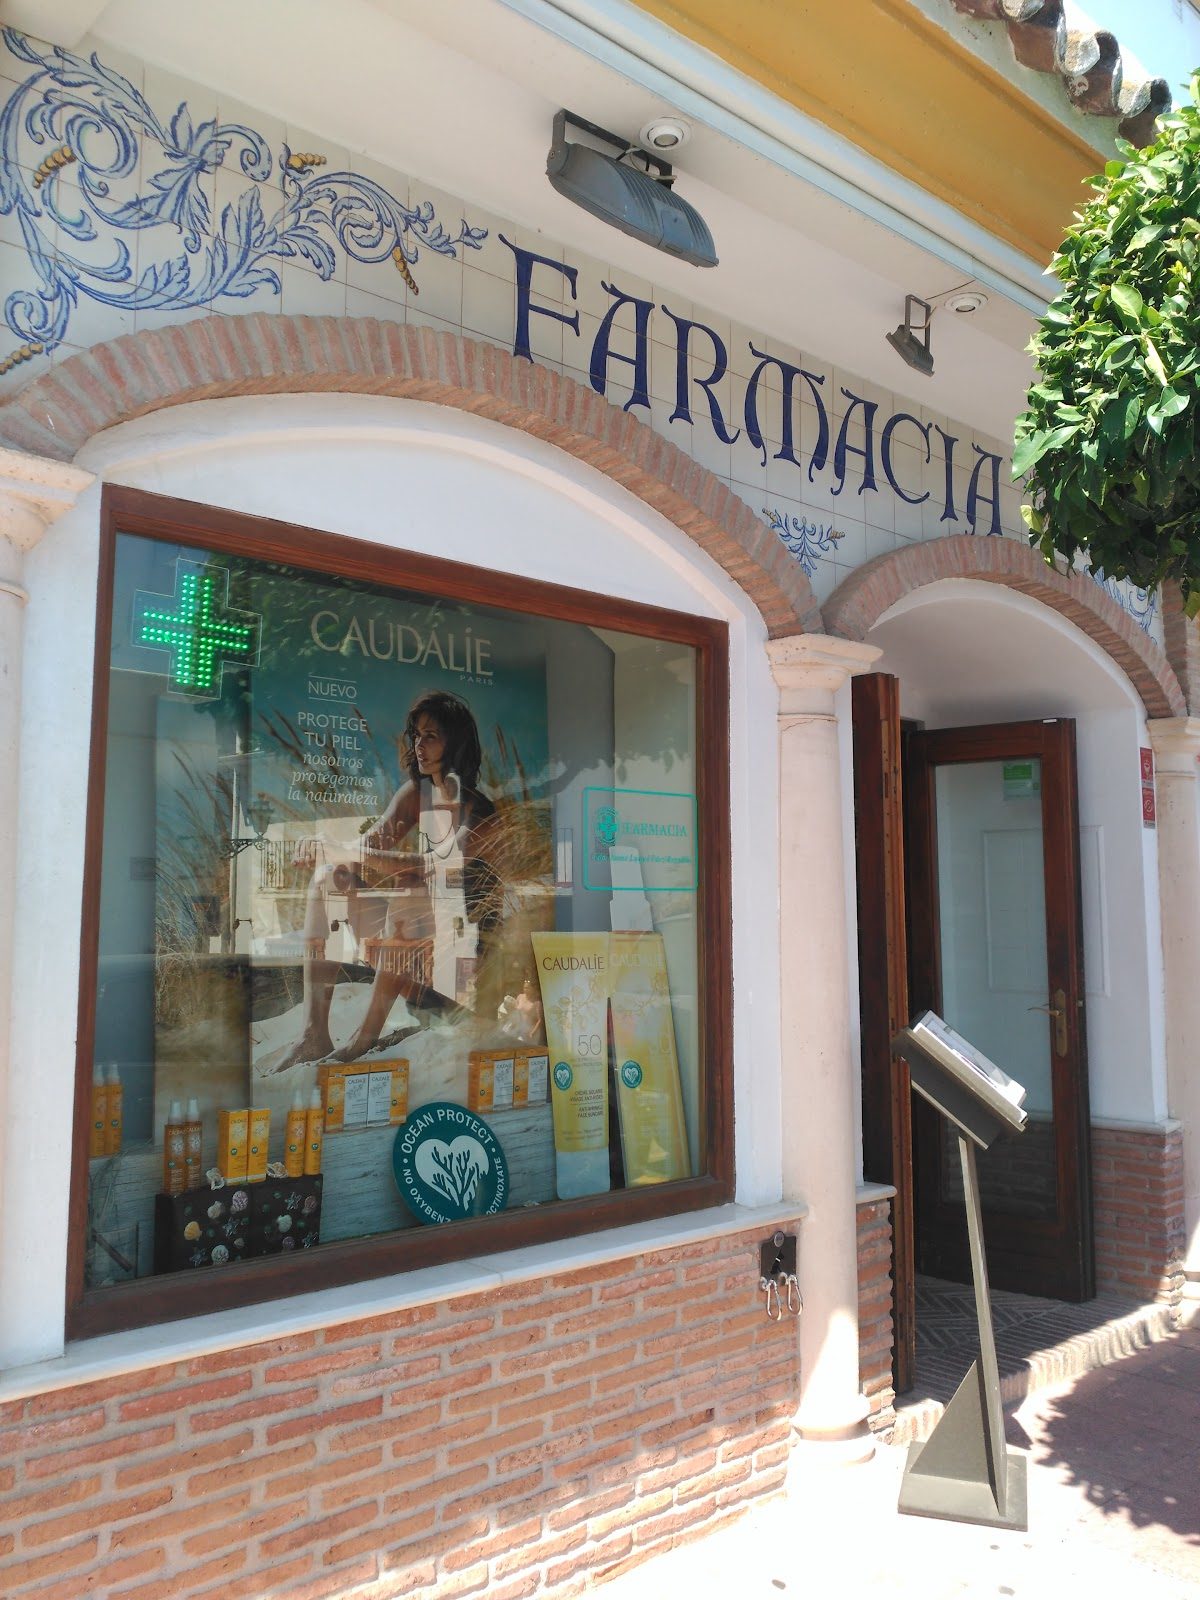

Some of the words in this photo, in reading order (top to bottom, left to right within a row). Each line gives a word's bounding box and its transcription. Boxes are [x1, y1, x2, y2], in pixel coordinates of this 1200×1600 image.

[498, 233, 1003, 536] FARMACIA
[459, 675, 494, 686] PARIS
[308, 681, 357, 699] NUEVO
[298, 712, 367, 732] PROTEGE
[305, 732, 326, 747] TU
[332, 735, 361, 751] PIEL
[303, 753, 364, 769] nosotros
[292, 771, 374, 788] protegemos
[288, 787, 301, 801] la
[305, 790, 378, 806] naturaleza
[622, 822, 687, 836] FARMACIA
[578, 1034, 602, 1056] 50
[401, 1112, 434, 1154] OCEAN
[437, 1109, 493, 1144] PROTECT
[403, 1168, 413, 1184] NO
